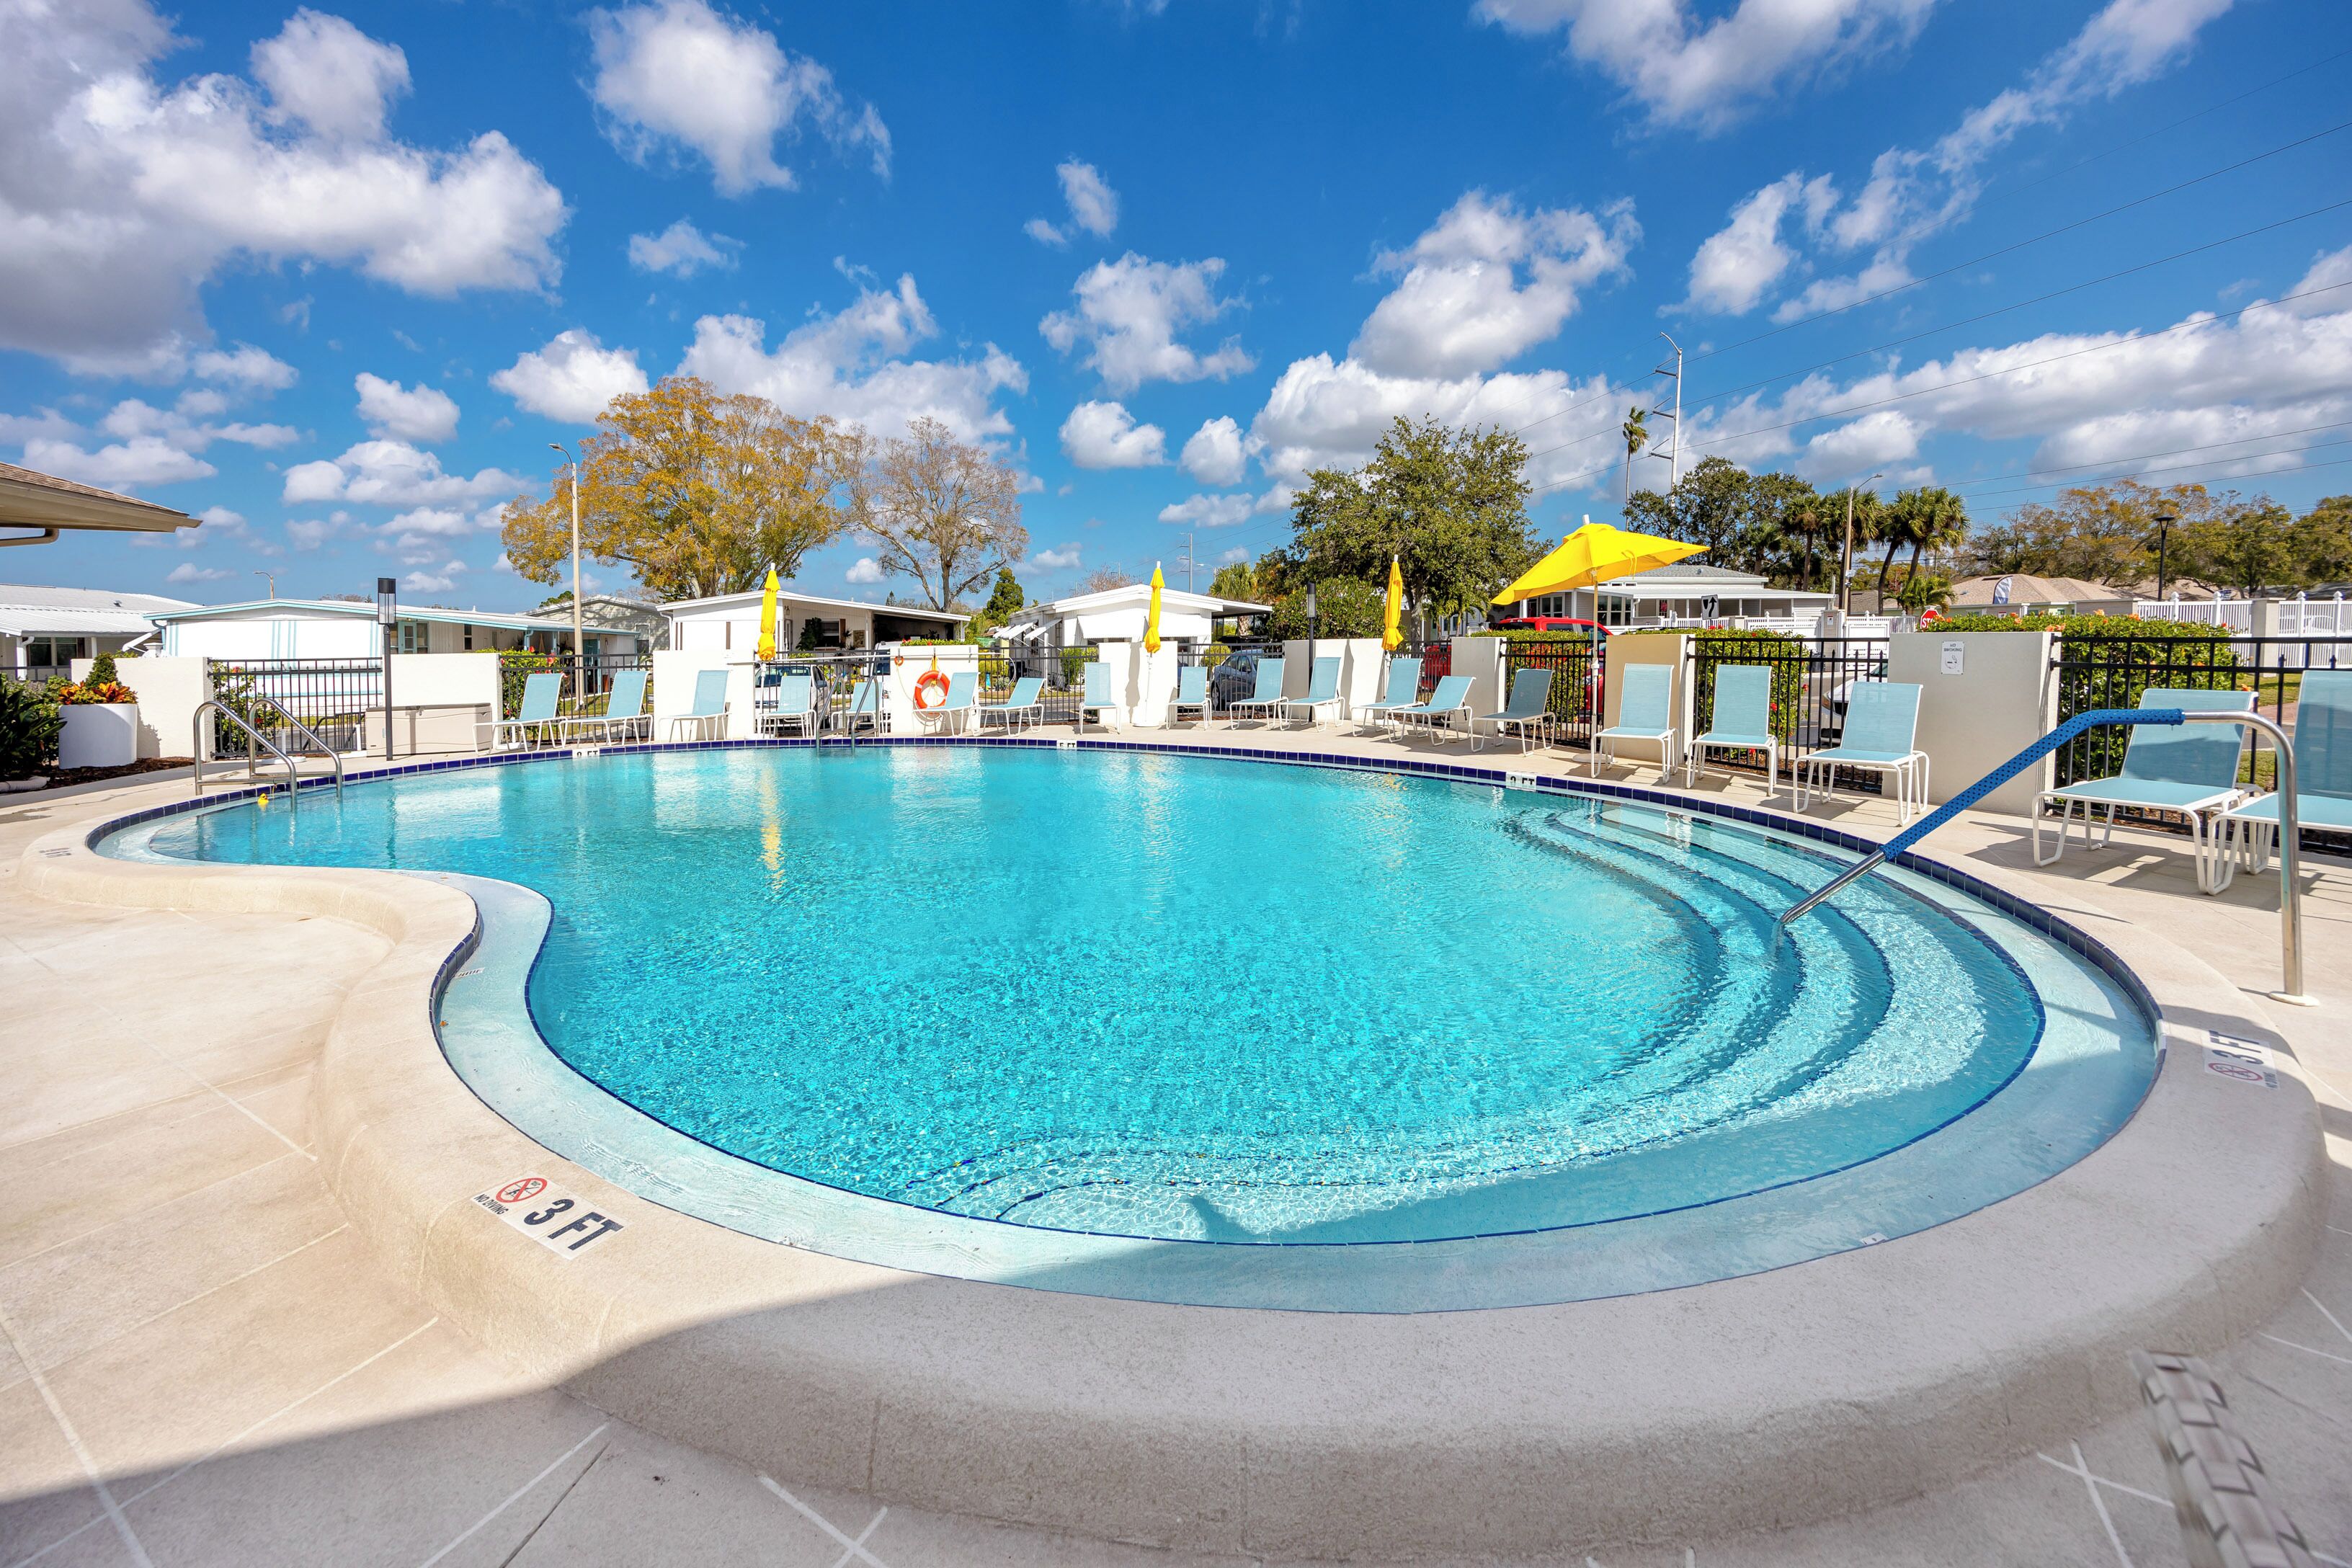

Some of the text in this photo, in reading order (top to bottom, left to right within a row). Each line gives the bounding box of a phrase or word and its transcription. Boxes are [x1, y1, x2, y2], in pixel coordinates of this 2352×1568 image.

[2209, 1030, 2264, 1065] 3 FT
[473, 1194, 509, 1215] NO DIVING
[523, 1198, 625, 1251] 3 FT
